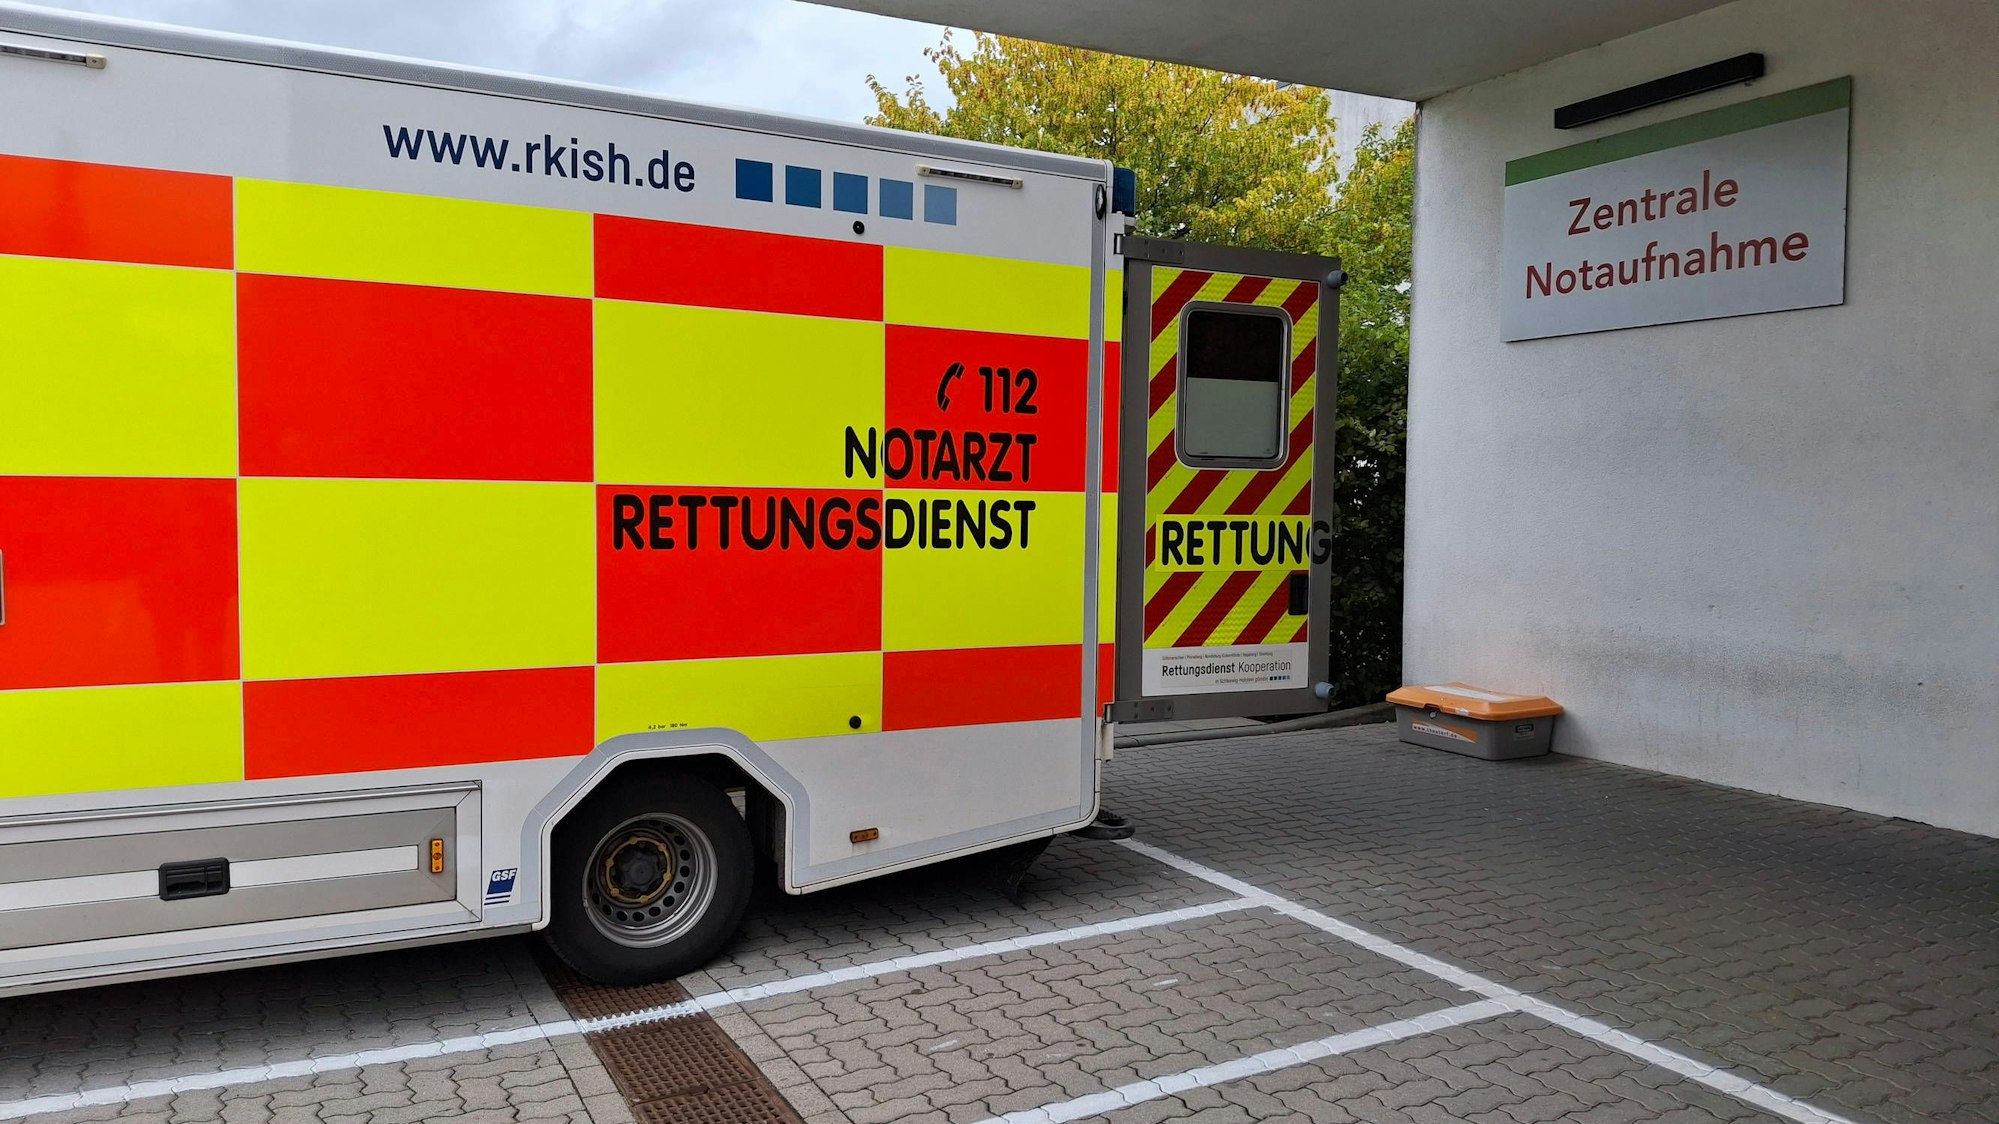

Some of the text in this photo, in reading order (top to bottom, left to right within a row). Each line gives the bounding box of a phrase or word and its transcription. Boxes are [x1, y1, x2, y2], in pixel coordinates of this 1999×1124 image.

[382, 124, 696, 193] www.rkish.de
[1567, 168, 1740, 236] Zentrale
[1525, 231, 1810, 300] Notaufnahme
[978, 366, 1039, 415] 112
[844, 425, 1038, 483] NOTARZT
[612, 493, 1037, 551] RETTUNGSDIENST
[1161, 520, 1332, 566] RETTUNG
[1161, 660, 1291, 678] Rettungsdienst Kooperation
[492, 869, 515, 881] GSF
